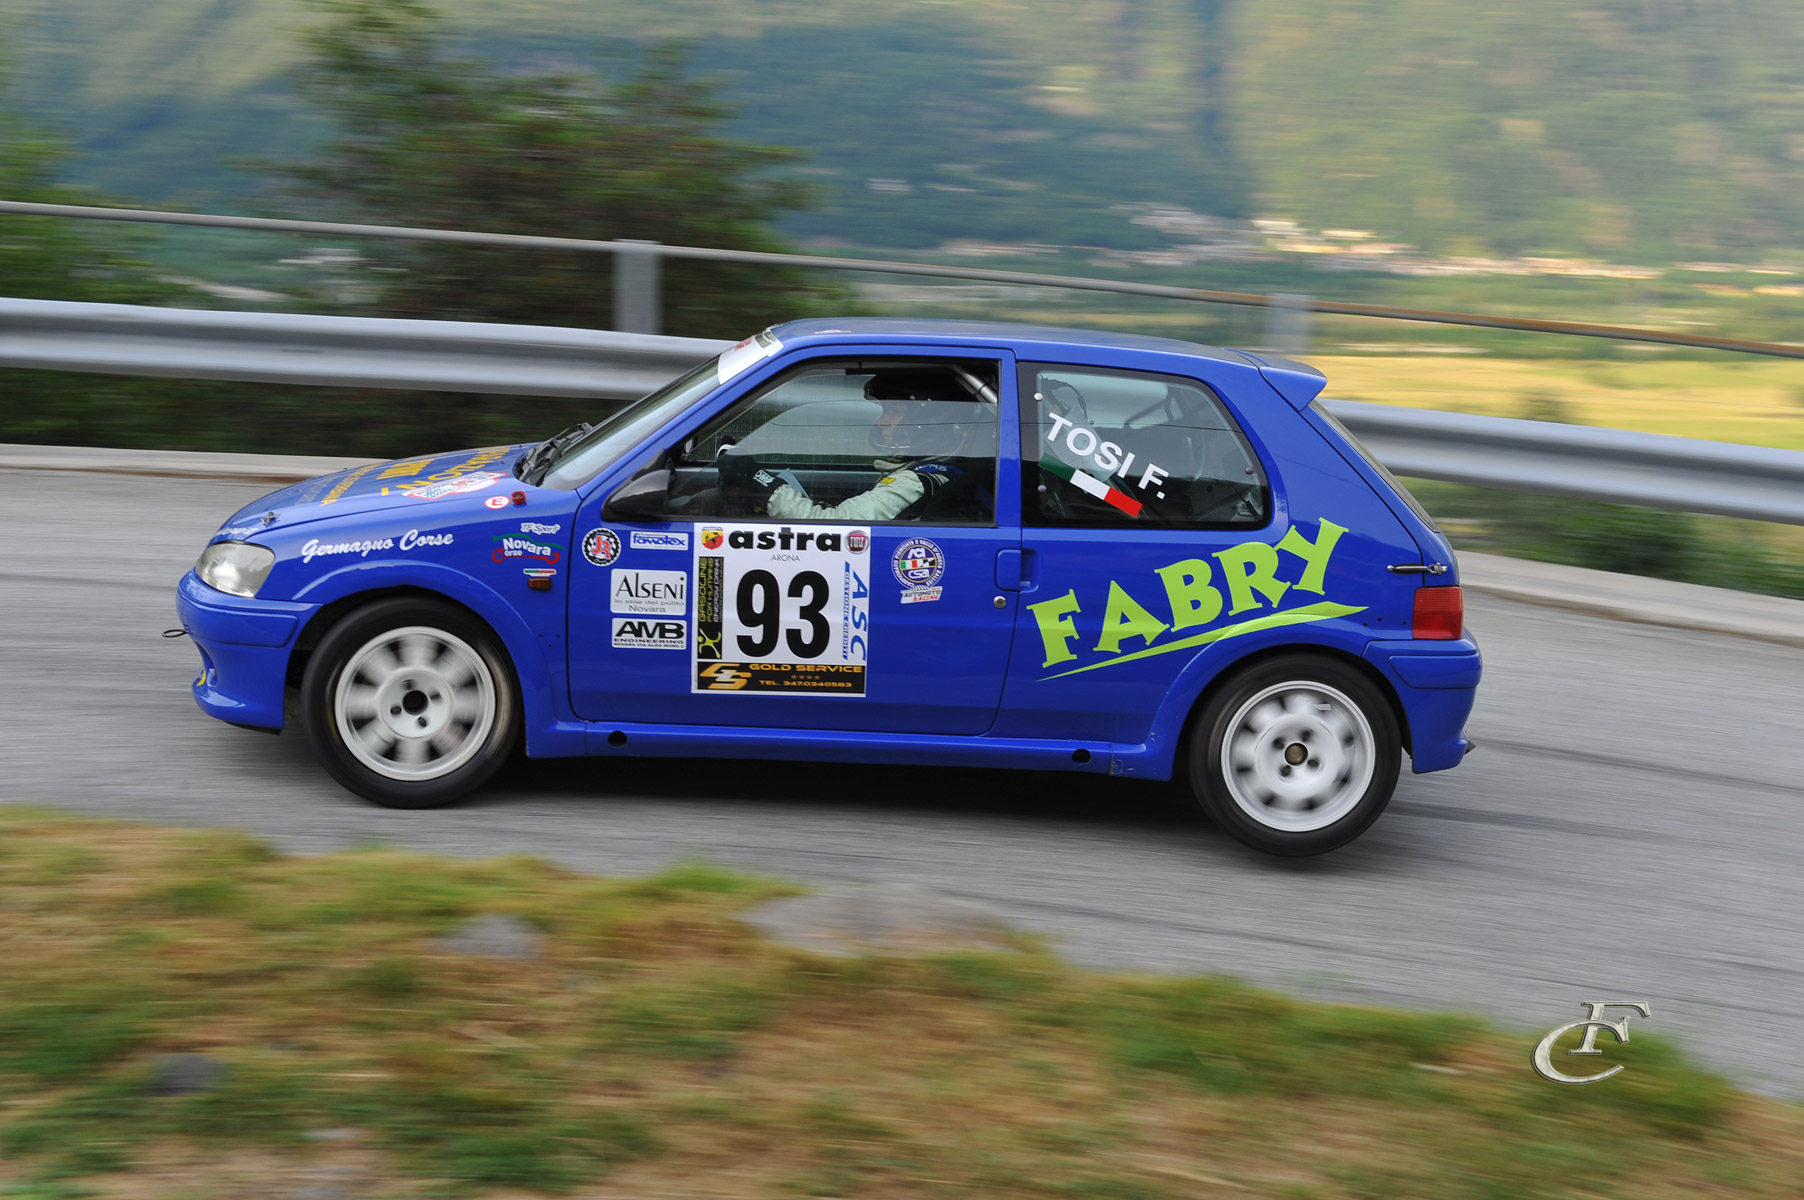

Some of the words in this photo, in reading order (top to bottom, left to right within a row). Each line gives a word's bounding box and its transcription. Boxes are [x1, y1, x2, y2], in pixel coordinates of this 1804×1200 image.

[1047, 412, 1136, 478] TOSI
[1138, 463, 1169, 499] F.
[755, 470, 773, 483] OMP
[301, 539, 394, 564] Germagno
[399, 529, 454, 551] Corse
[503, 538, 552, 556] Novara
[728, 527, 841, 552] astra
[771, 554, 800, 562] ARONA
[699, 557, 707, 622] GASOLINE
[1026, 517, 1349, 668] FABRY
[735, 569, 830, 659] 93
[851, 569, 868, 661] ASC
[615, 621, 684, 639] AMB
[749, 663, 791, 671] GOLD
[795, 665, 863, 674] SERVICE
